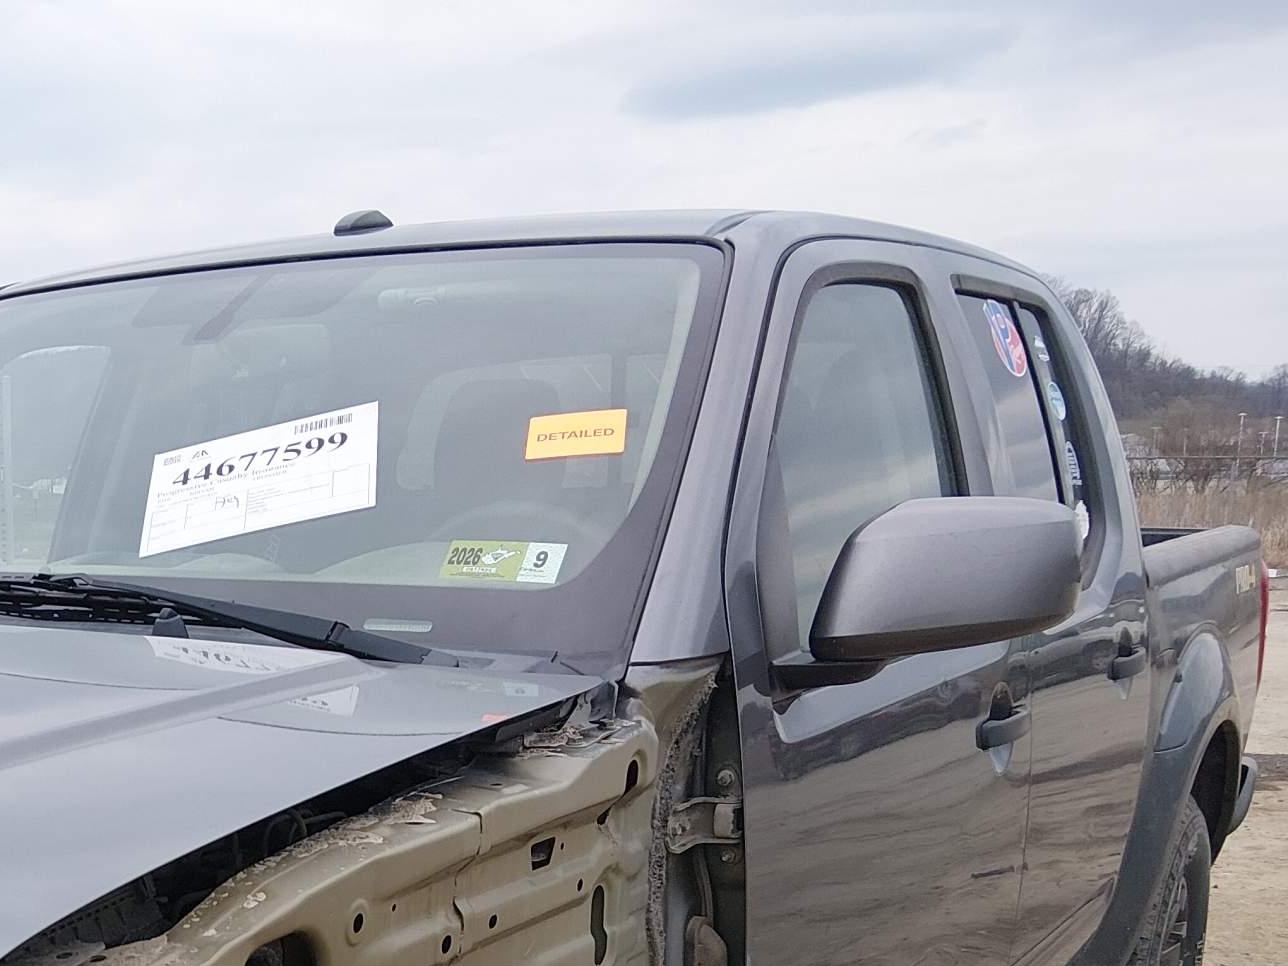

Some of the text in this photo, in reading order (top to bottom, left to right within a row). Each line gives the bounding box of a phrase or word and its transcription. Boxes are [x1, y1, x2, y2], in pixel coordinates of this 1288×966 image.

[537, 428, 615, 442] DETAILED
[172, 431, 348, 486] 44677599
[447, 547, 549, 568] 2026 9
